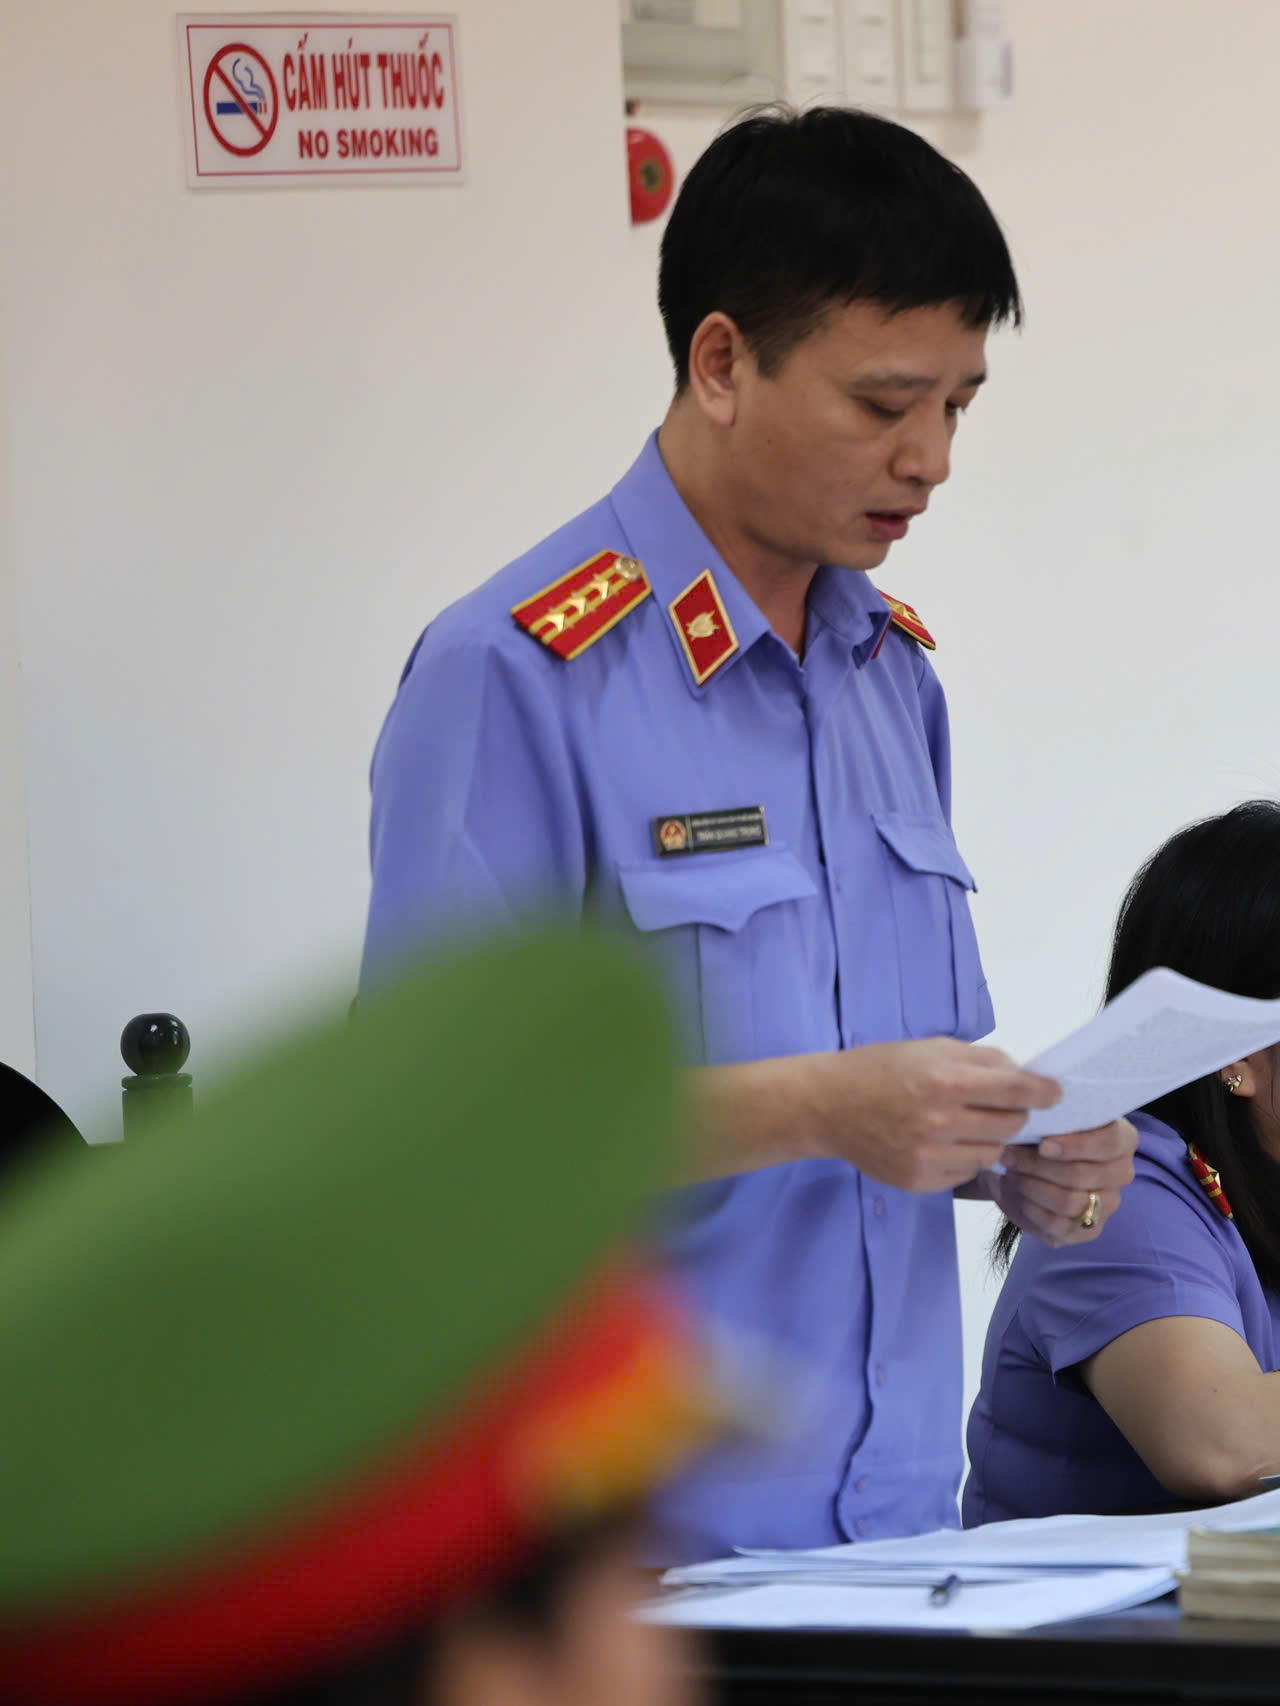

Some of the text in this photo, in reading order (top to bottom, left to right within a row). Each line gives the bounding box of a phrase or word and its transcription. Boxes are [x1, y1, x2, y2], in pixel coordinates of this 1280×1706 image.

[283, 32, 444, 112] CẤM HÚT THUỐC
[298, 128, 438, 158] NO SMOKING
